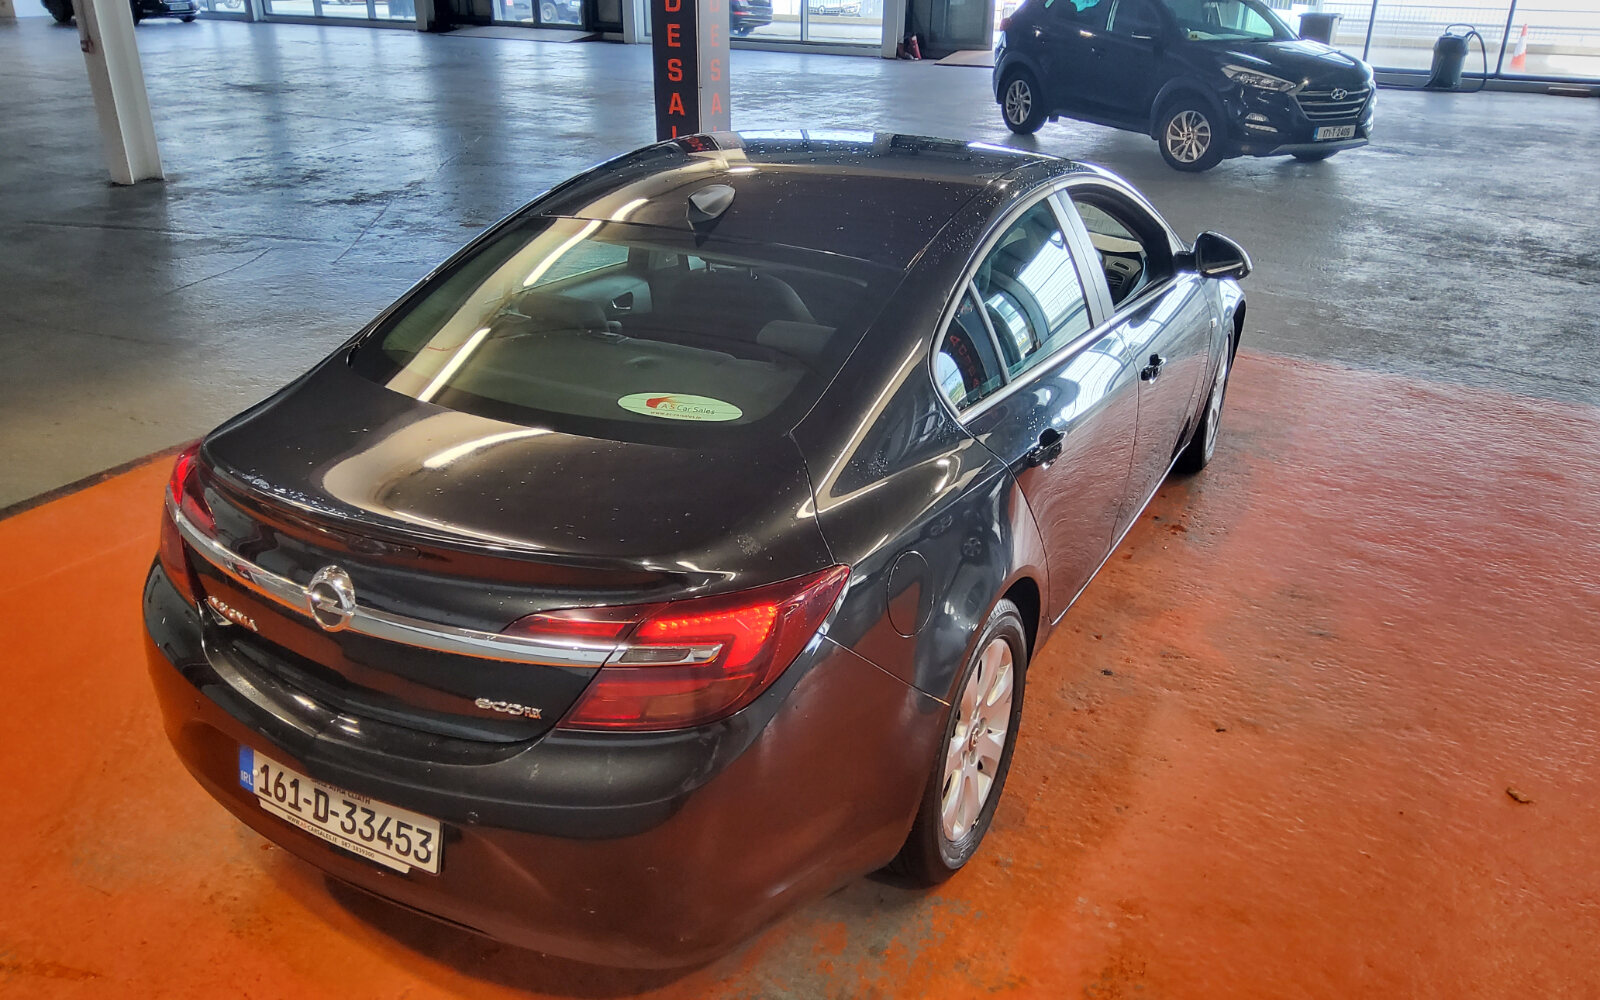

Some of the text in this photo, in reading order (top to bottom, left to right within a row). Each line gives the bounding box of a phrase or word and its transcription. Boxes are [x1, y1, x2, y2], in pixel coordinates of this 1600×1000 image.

[676, 404, 691, 413] Car
[692, 406, 716, 415] Sales
[240, 770, 254, 786] IRL
[259, 764, 433, 864] 161-D-33453
